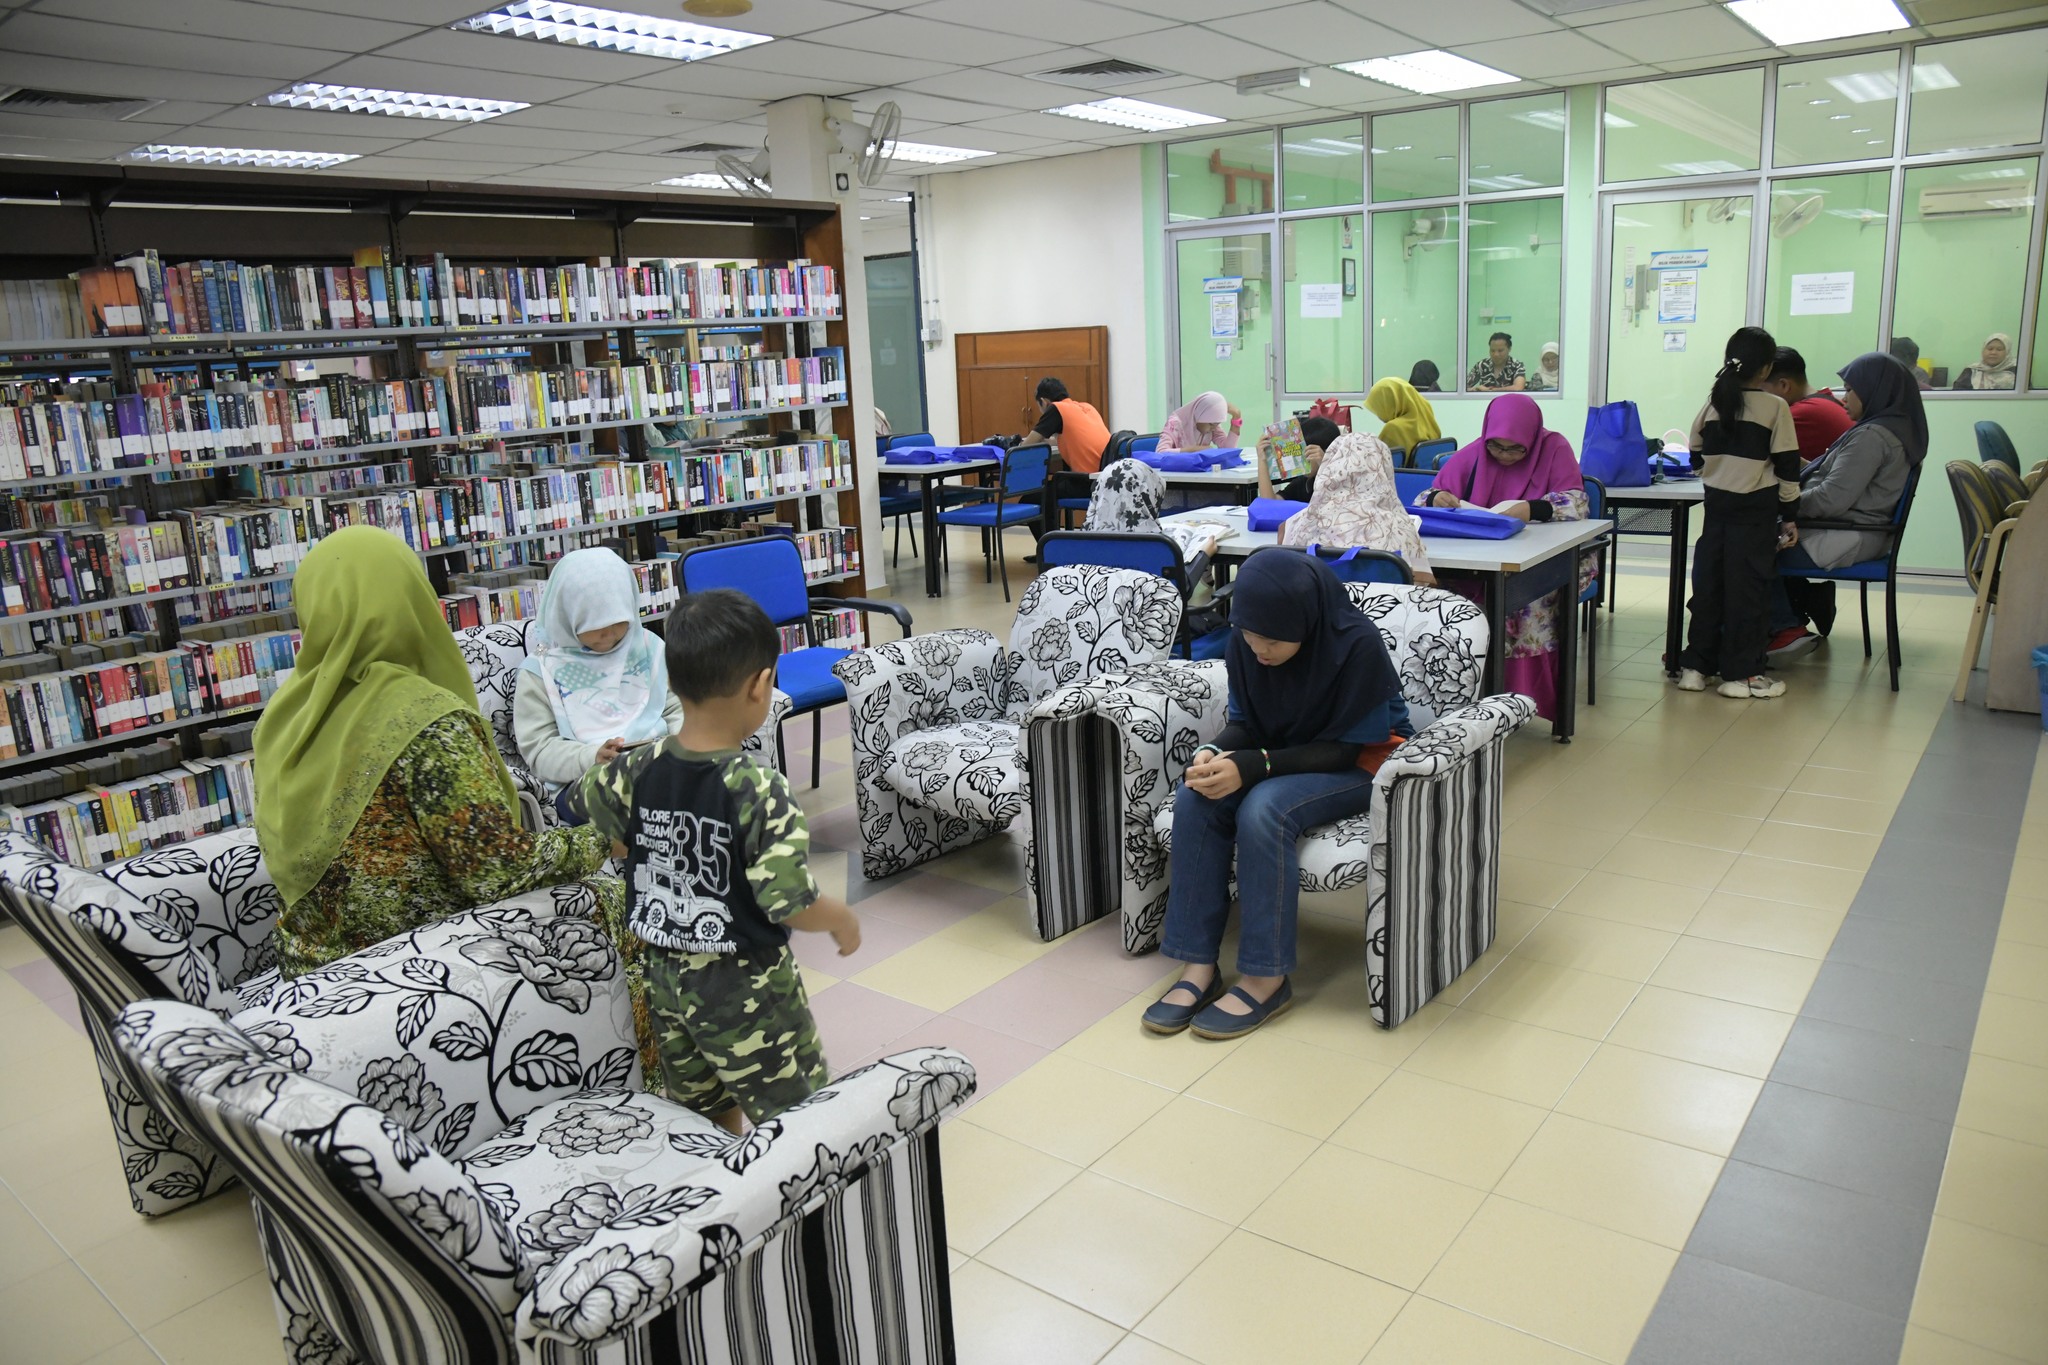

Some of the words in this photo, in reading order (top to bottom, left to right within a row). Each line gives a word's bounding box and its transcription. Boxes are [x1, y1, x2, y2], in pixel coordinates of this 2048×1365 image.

[385, 262, 393, 283] HARRY
[388, 283, 396, 306] POTTER
[0, 546, 10, 571] OWLING
[686, 940, 737, 953] highlands
